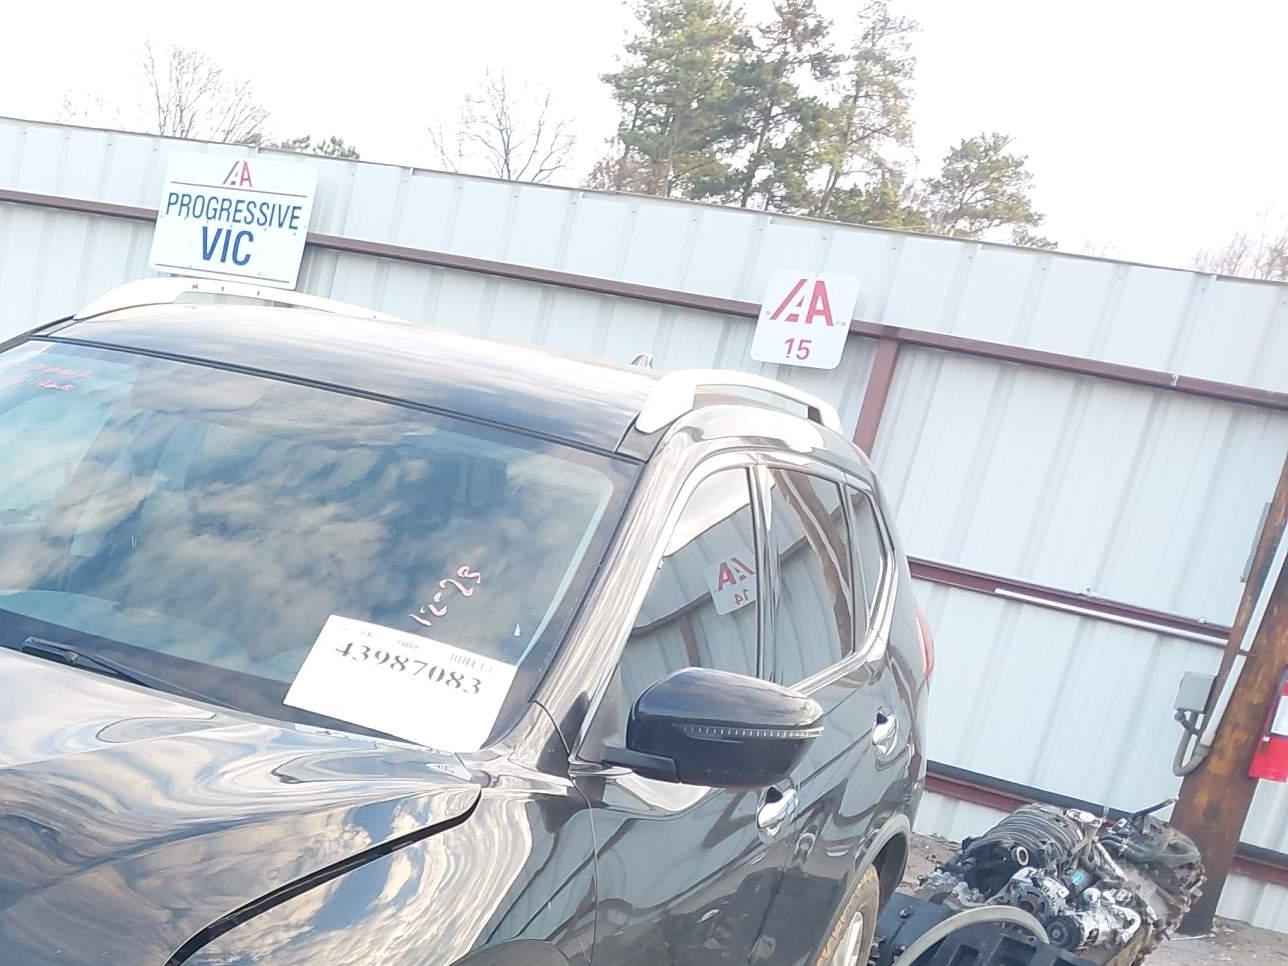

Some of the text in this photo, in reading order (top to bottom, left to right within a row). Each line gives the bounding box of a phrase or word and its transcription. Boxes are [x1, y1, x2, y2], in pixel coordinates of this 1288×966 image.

[166, 192, 303, 230] PROGRESSIVE
[201, 226, 254, 266] VIC
[784, 338, 812, 360] 15
[335, 641, 482, 695] 43987083
